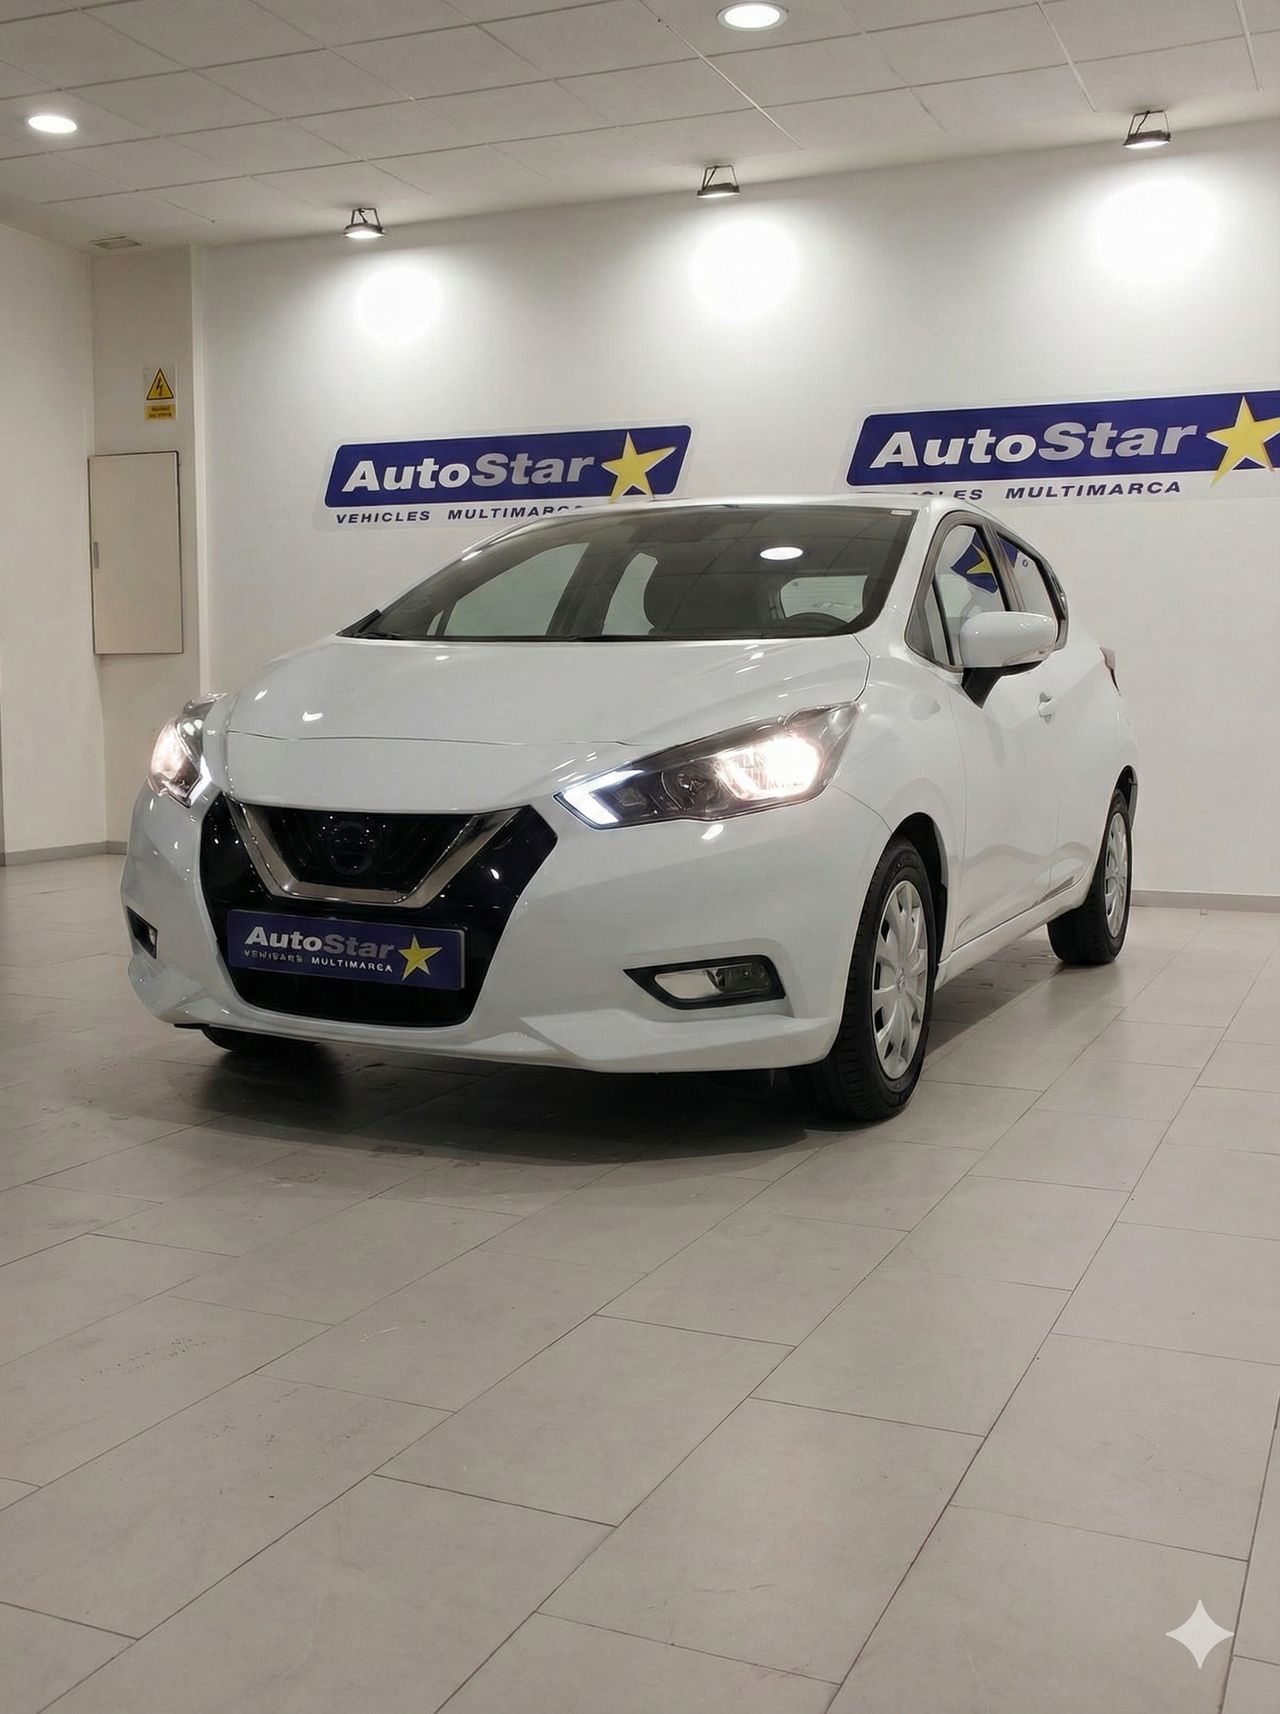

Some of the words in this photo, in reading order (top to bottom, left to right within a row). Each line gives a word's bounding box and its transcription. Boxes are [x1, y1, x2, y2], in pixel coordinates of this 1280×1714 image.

[869, 422, 1197, 469] AutoStar
[341, 453, 595, 493] AutoStar
[1005, 481, 1181, 499] MULTIMARCA
[336, 510, 431, 524] VEHICLES
[447, 505, 583, 520] MULTIMAR
[245, 926, 395, 959] AutoStar
[311, 956, 393, 972] MULTIMARCA
